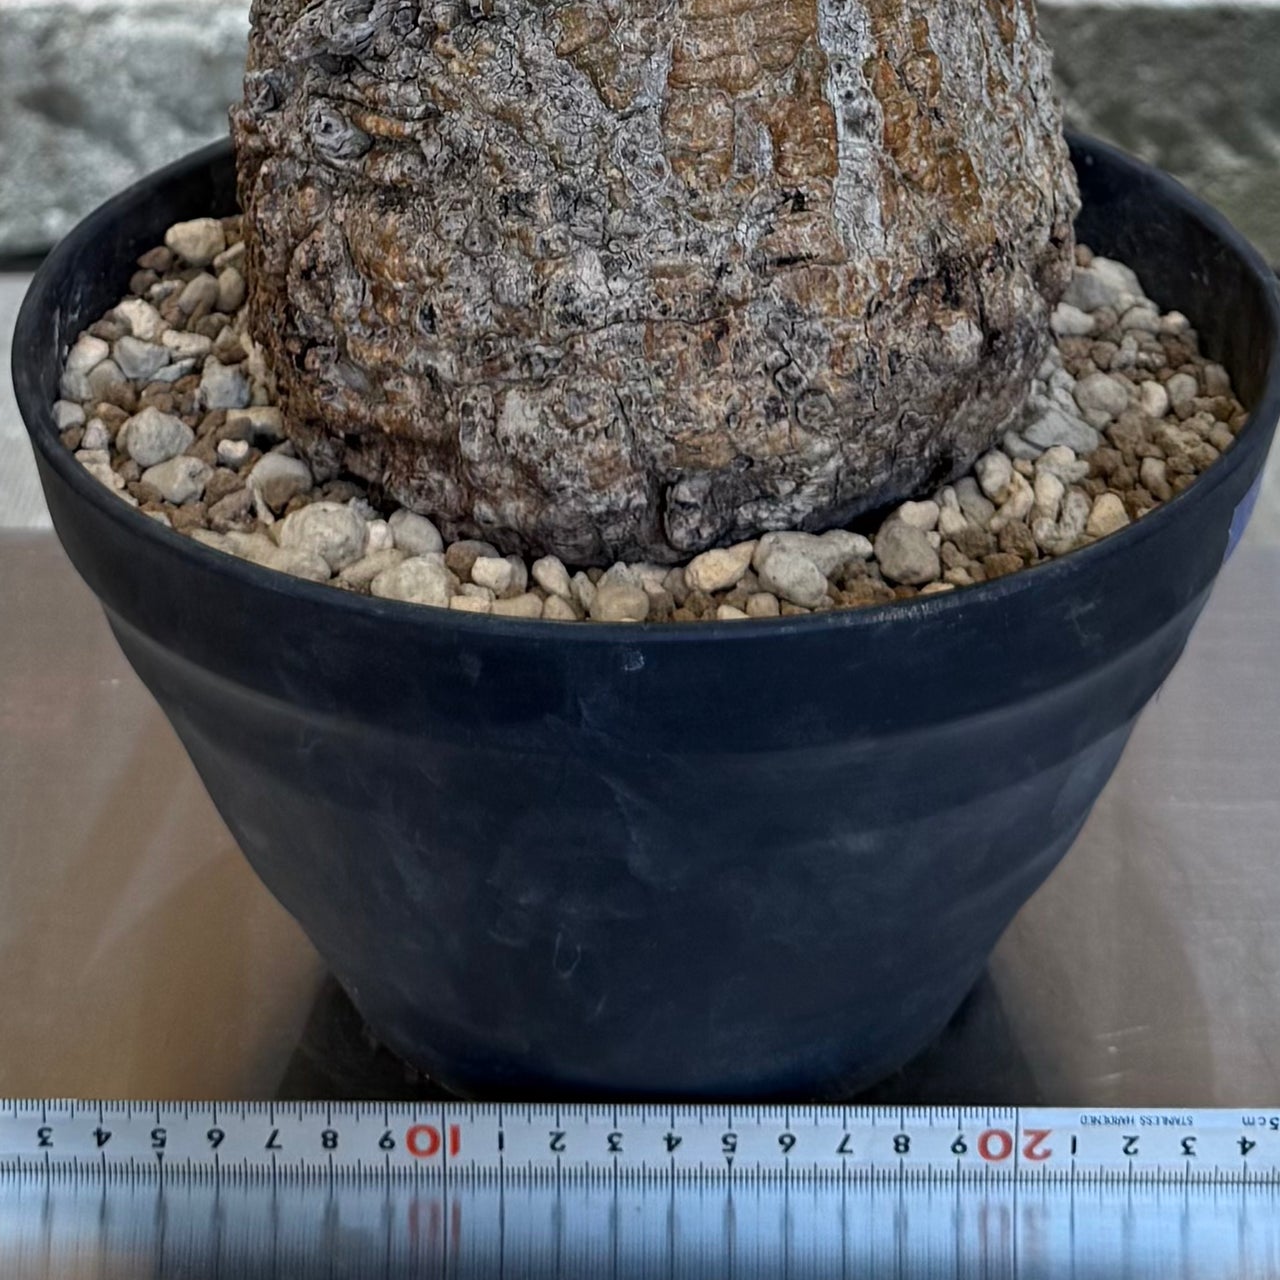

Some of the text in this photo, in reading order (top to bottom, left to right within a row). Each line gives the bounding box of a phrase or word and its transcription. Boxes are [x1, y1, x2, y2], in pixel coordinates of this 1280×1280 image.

[37, 1127, 53, 1147] 3
[94, 1127, 112, 1148] 4
[151, 1128, 166, 1148] 5
[207, 1128, 225, 1148] 6
[265, 1129, 283, 1150] 7
[322, 1128, 338, 1150] 8
[379, 1128, 396, 1150] 9
[549, 1130, 567, 1151] 2
[607, 1130, 625, 1151] 3
[664, 1133, 683, 1153] 4
[721, 1133, 737, 1153] 5
[778, 1133, 797, 1154] 6
[836, 1133, 854, 1154] 7
[894, 1133, 910, 1154] 8
[950, 1133, 968, 1154] 9
[1122, 1136, 1140, 1155] 2
[1180, 1137, 1196, 1156] 3
[1237, 1136, 1256, 1155] 4
